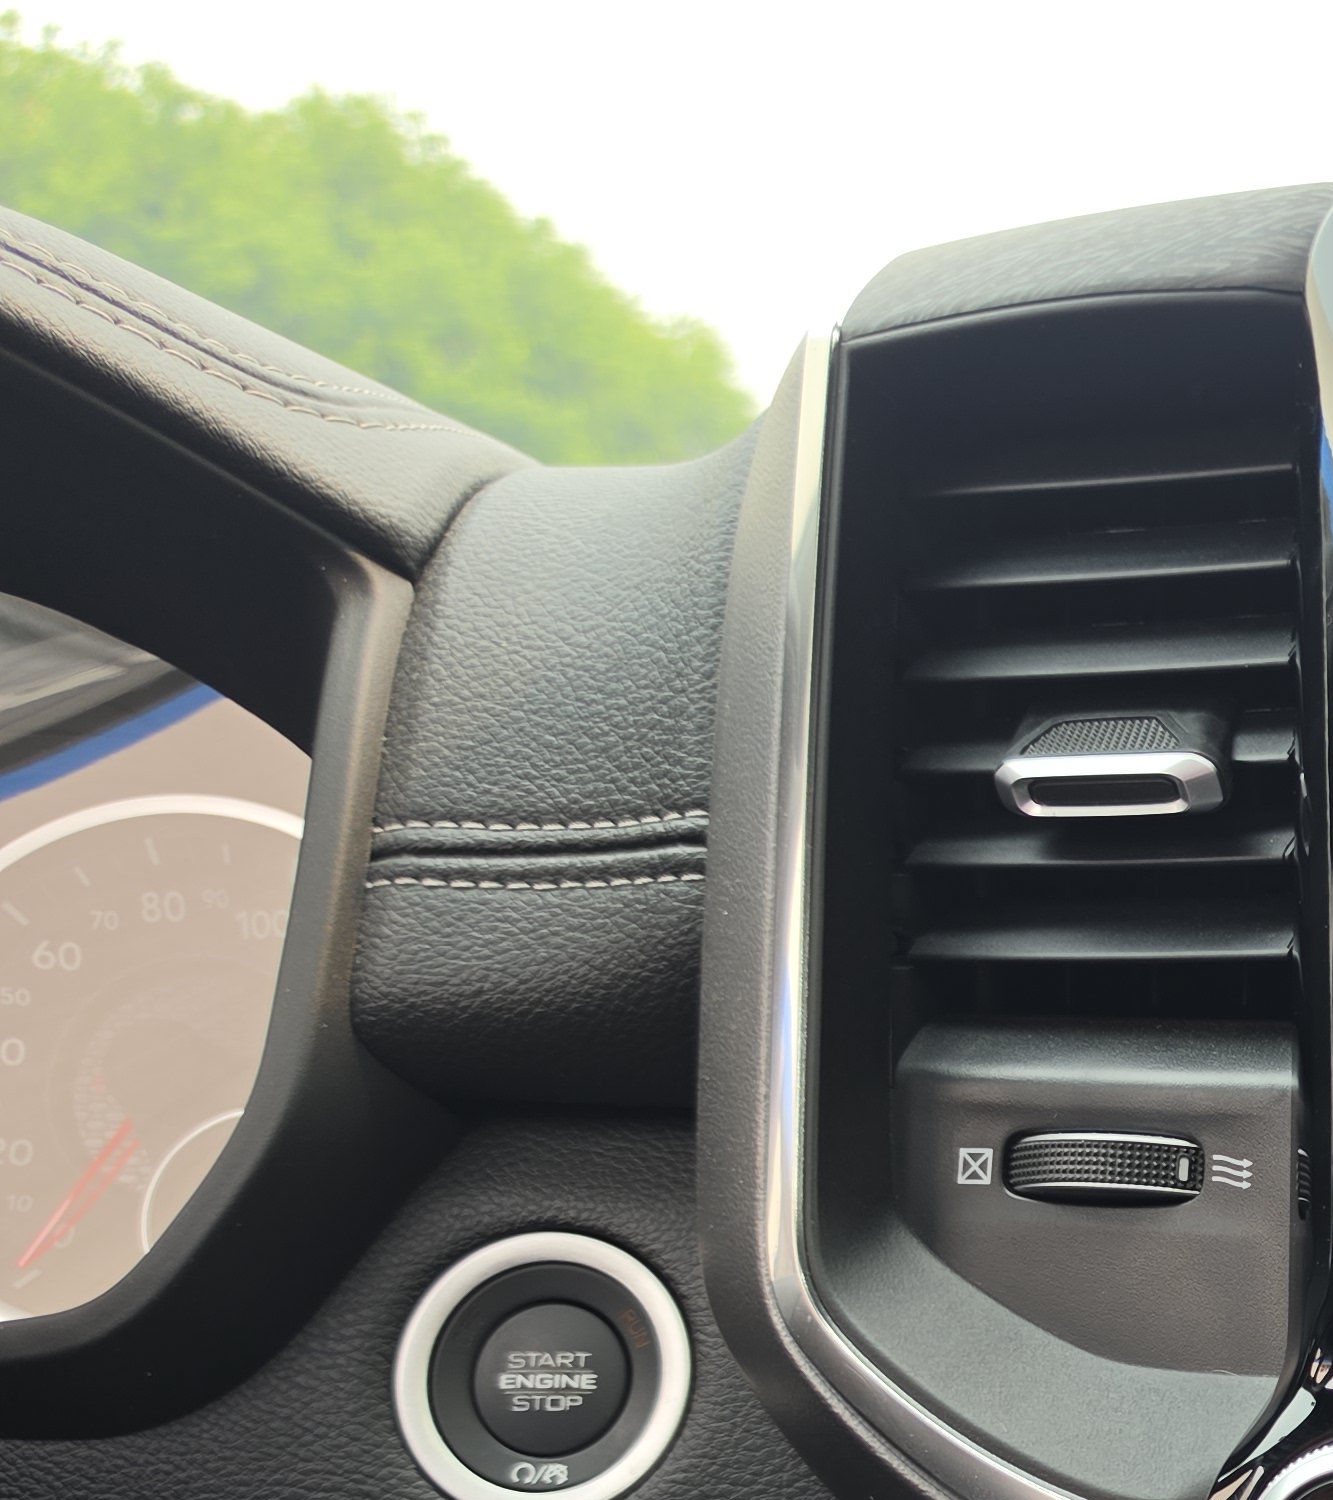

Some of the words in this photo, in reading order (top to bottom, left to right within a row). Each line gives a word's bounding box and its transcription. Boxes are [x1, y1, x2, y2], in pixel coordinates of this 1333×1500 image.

[141, 891, 186, 923] 80
[31, 940, 82, 971] 60
[507, 1352, 592, 1369] START
[499, 1373, 598, 1390] ENGINE
[512, 1395, 583, 1412] STOP
